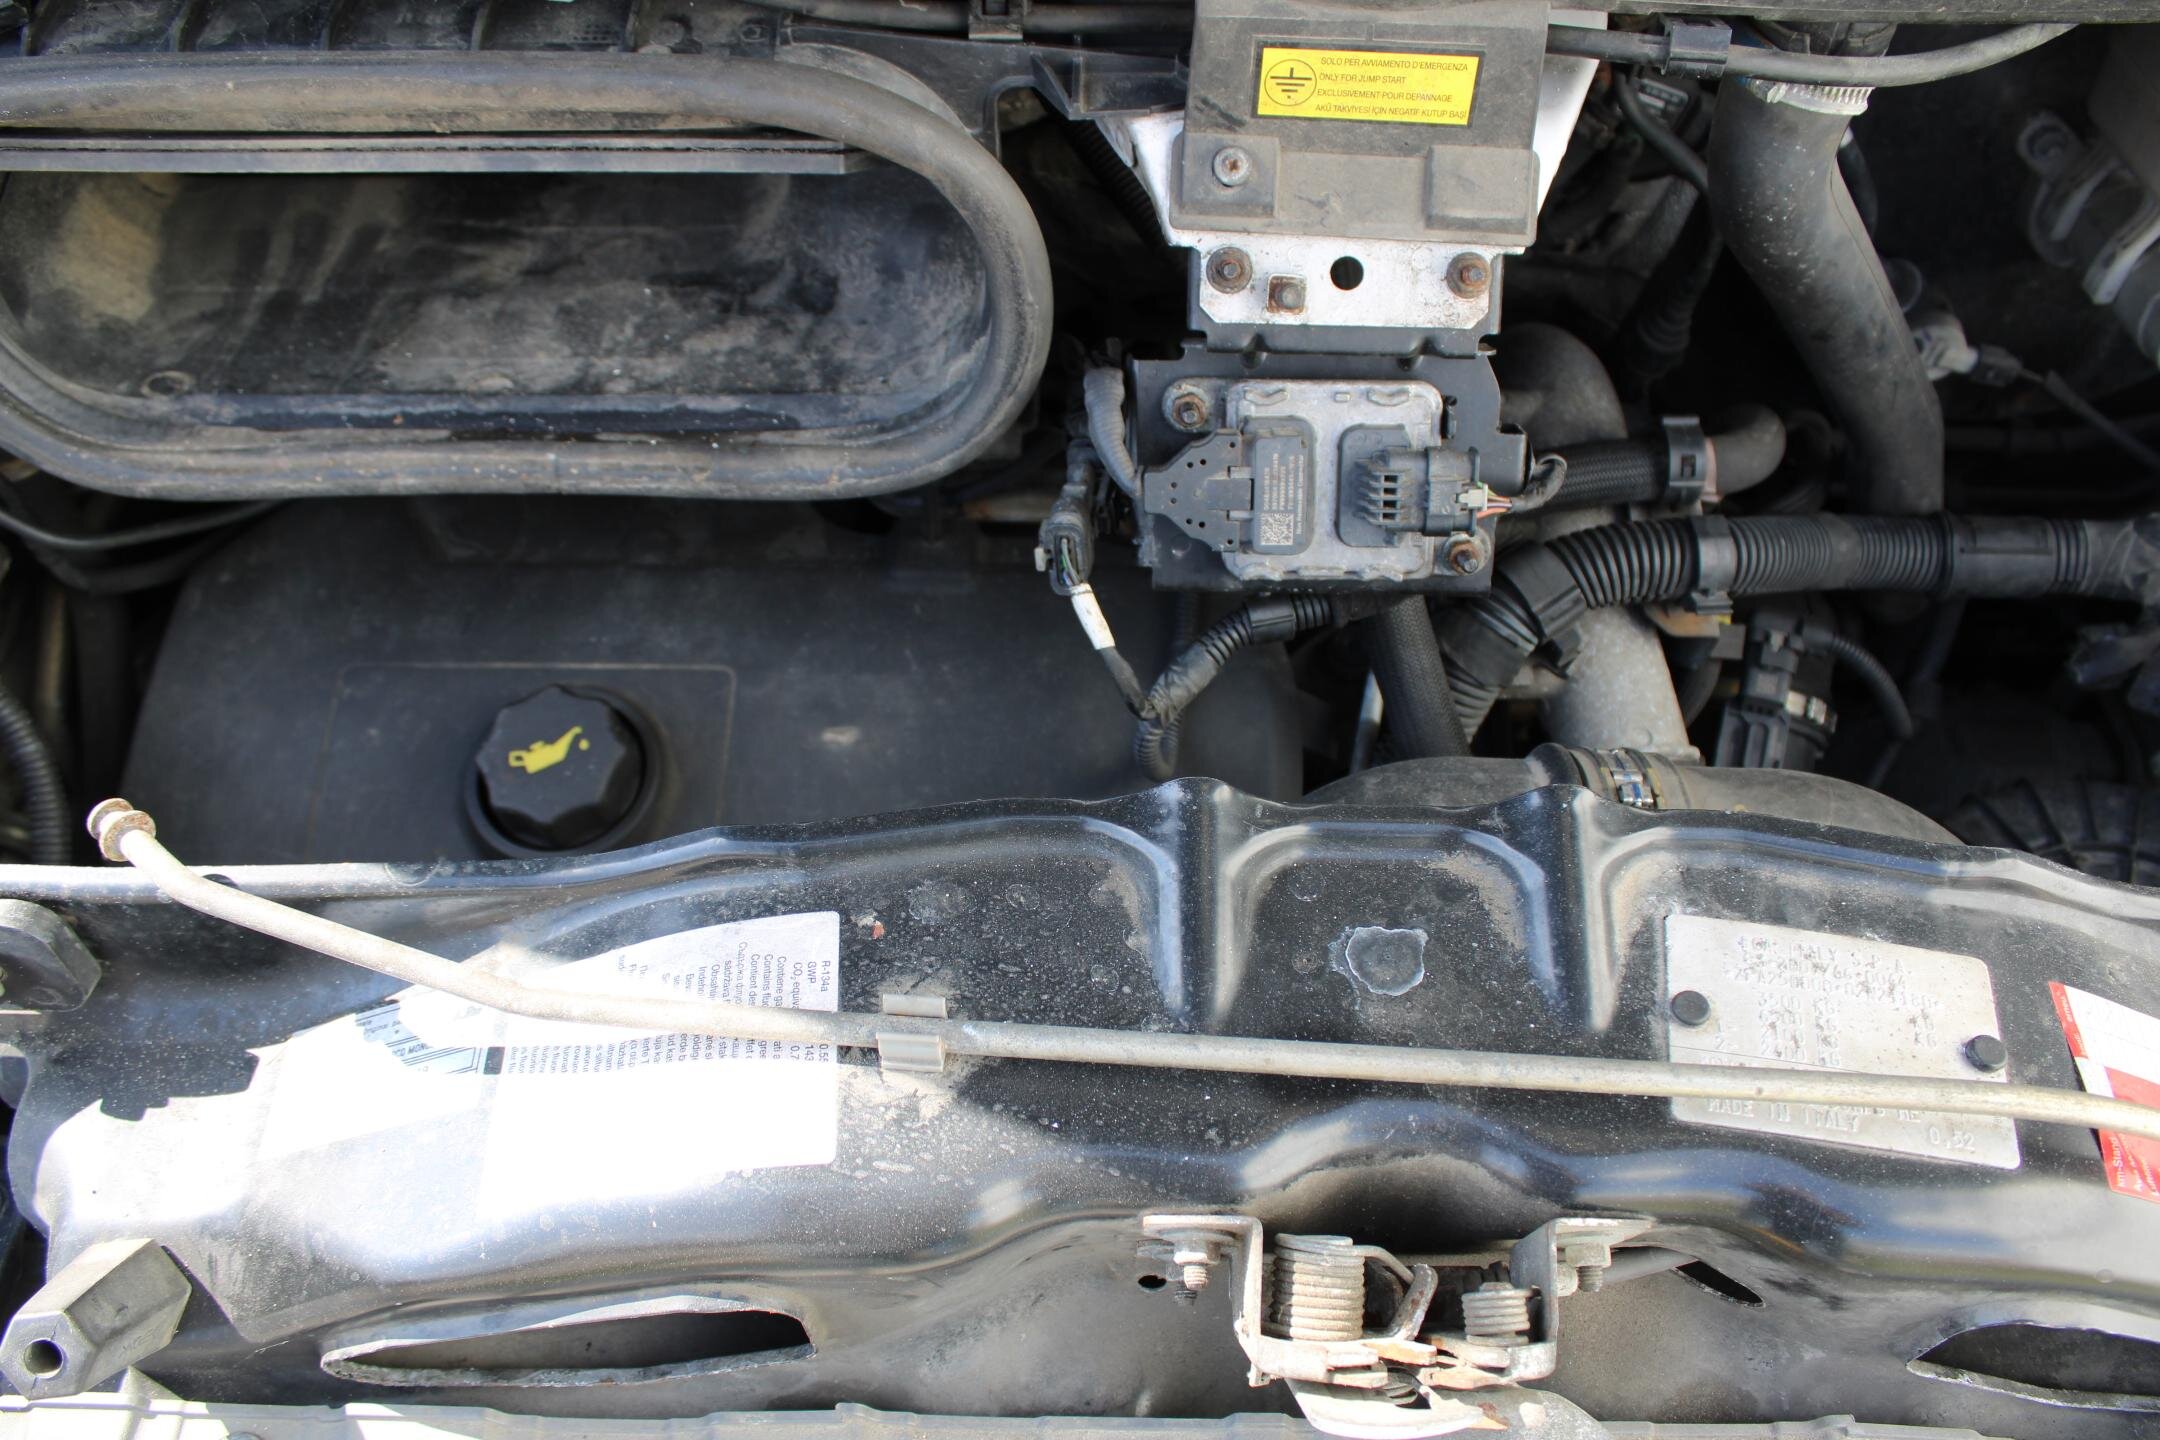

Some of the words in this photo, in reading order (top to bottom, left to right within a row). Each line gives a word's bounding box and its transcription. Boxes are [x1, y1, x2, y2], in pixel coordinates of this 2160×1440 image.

[1321, 57, 1342, 65] SOLO
[1344, 58, 1360, 66] PER
[1361, 59, 1411, 68] AVVIAMENTO
[1412, 61, 1468, 71] D'EMERGENZA
[1319, 72, 1339, 81] ONLY
[1341, 73, 1355, 82] FOR
[1356, 74, 1381, 82] JUMP
[1382, 75, 1407, 84] START
[1317, 88, 1380, 99] EXCLUSIVEMENT
[1381, 91, 1405, 100] POUR
[1422, 108, 1448, 118] KUTUP
[749, 953, 761, 989] Contient
[762, 953, 774, 991] Contains
[775, 956, 787, 994] Contiene
[807, 961, 817, 984] GWP
[820, 960, 831, 992] R-134a
[790, 981, 802, 1009] equiva
[805, 1044, 815, 1062] 143
[1708, 1099, 1754, 1118] MADE
[1769, 1103, 1791, 1122] IN
[1803, 1104, 1859, 1132] ITALY
